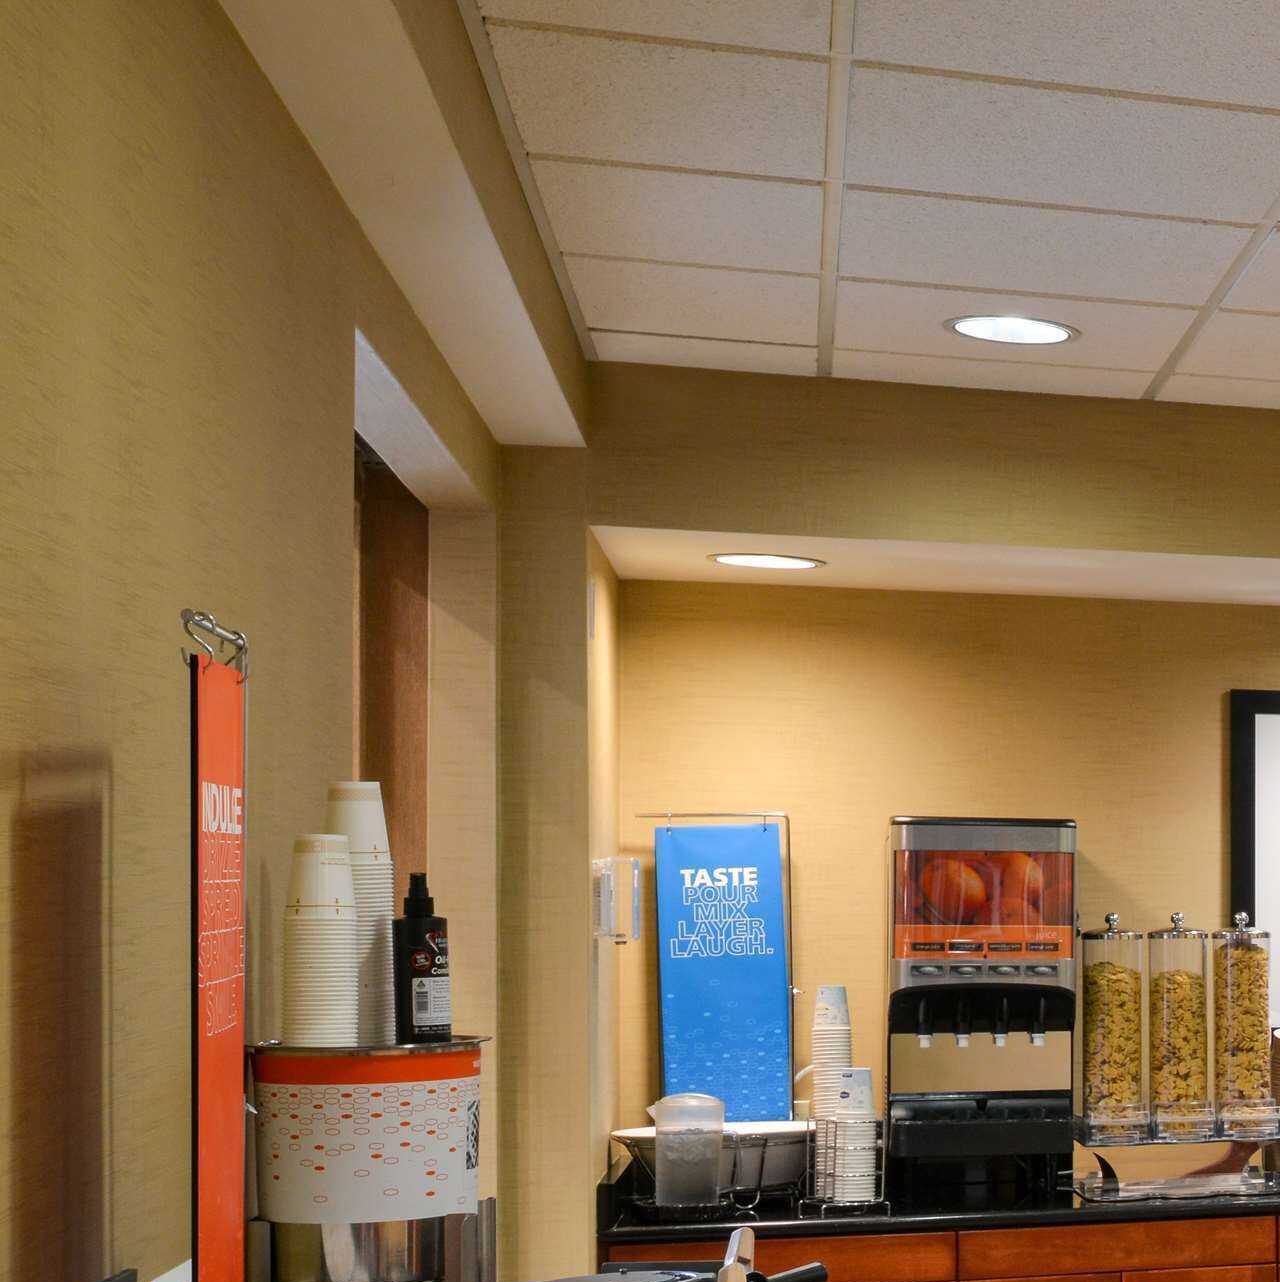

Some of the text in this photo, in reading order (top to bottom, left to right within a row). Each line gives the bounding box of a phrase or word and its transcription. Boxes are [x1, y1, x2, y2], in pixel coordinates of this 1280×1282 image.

[680, 867, 758, 887] TASTE
[682, 884, 758, 905] POUR
[693, 902, 750, 922] MIX
[678, 918, 766, 940] LAYER
[670, 936, 774, 958] LAUGH.
